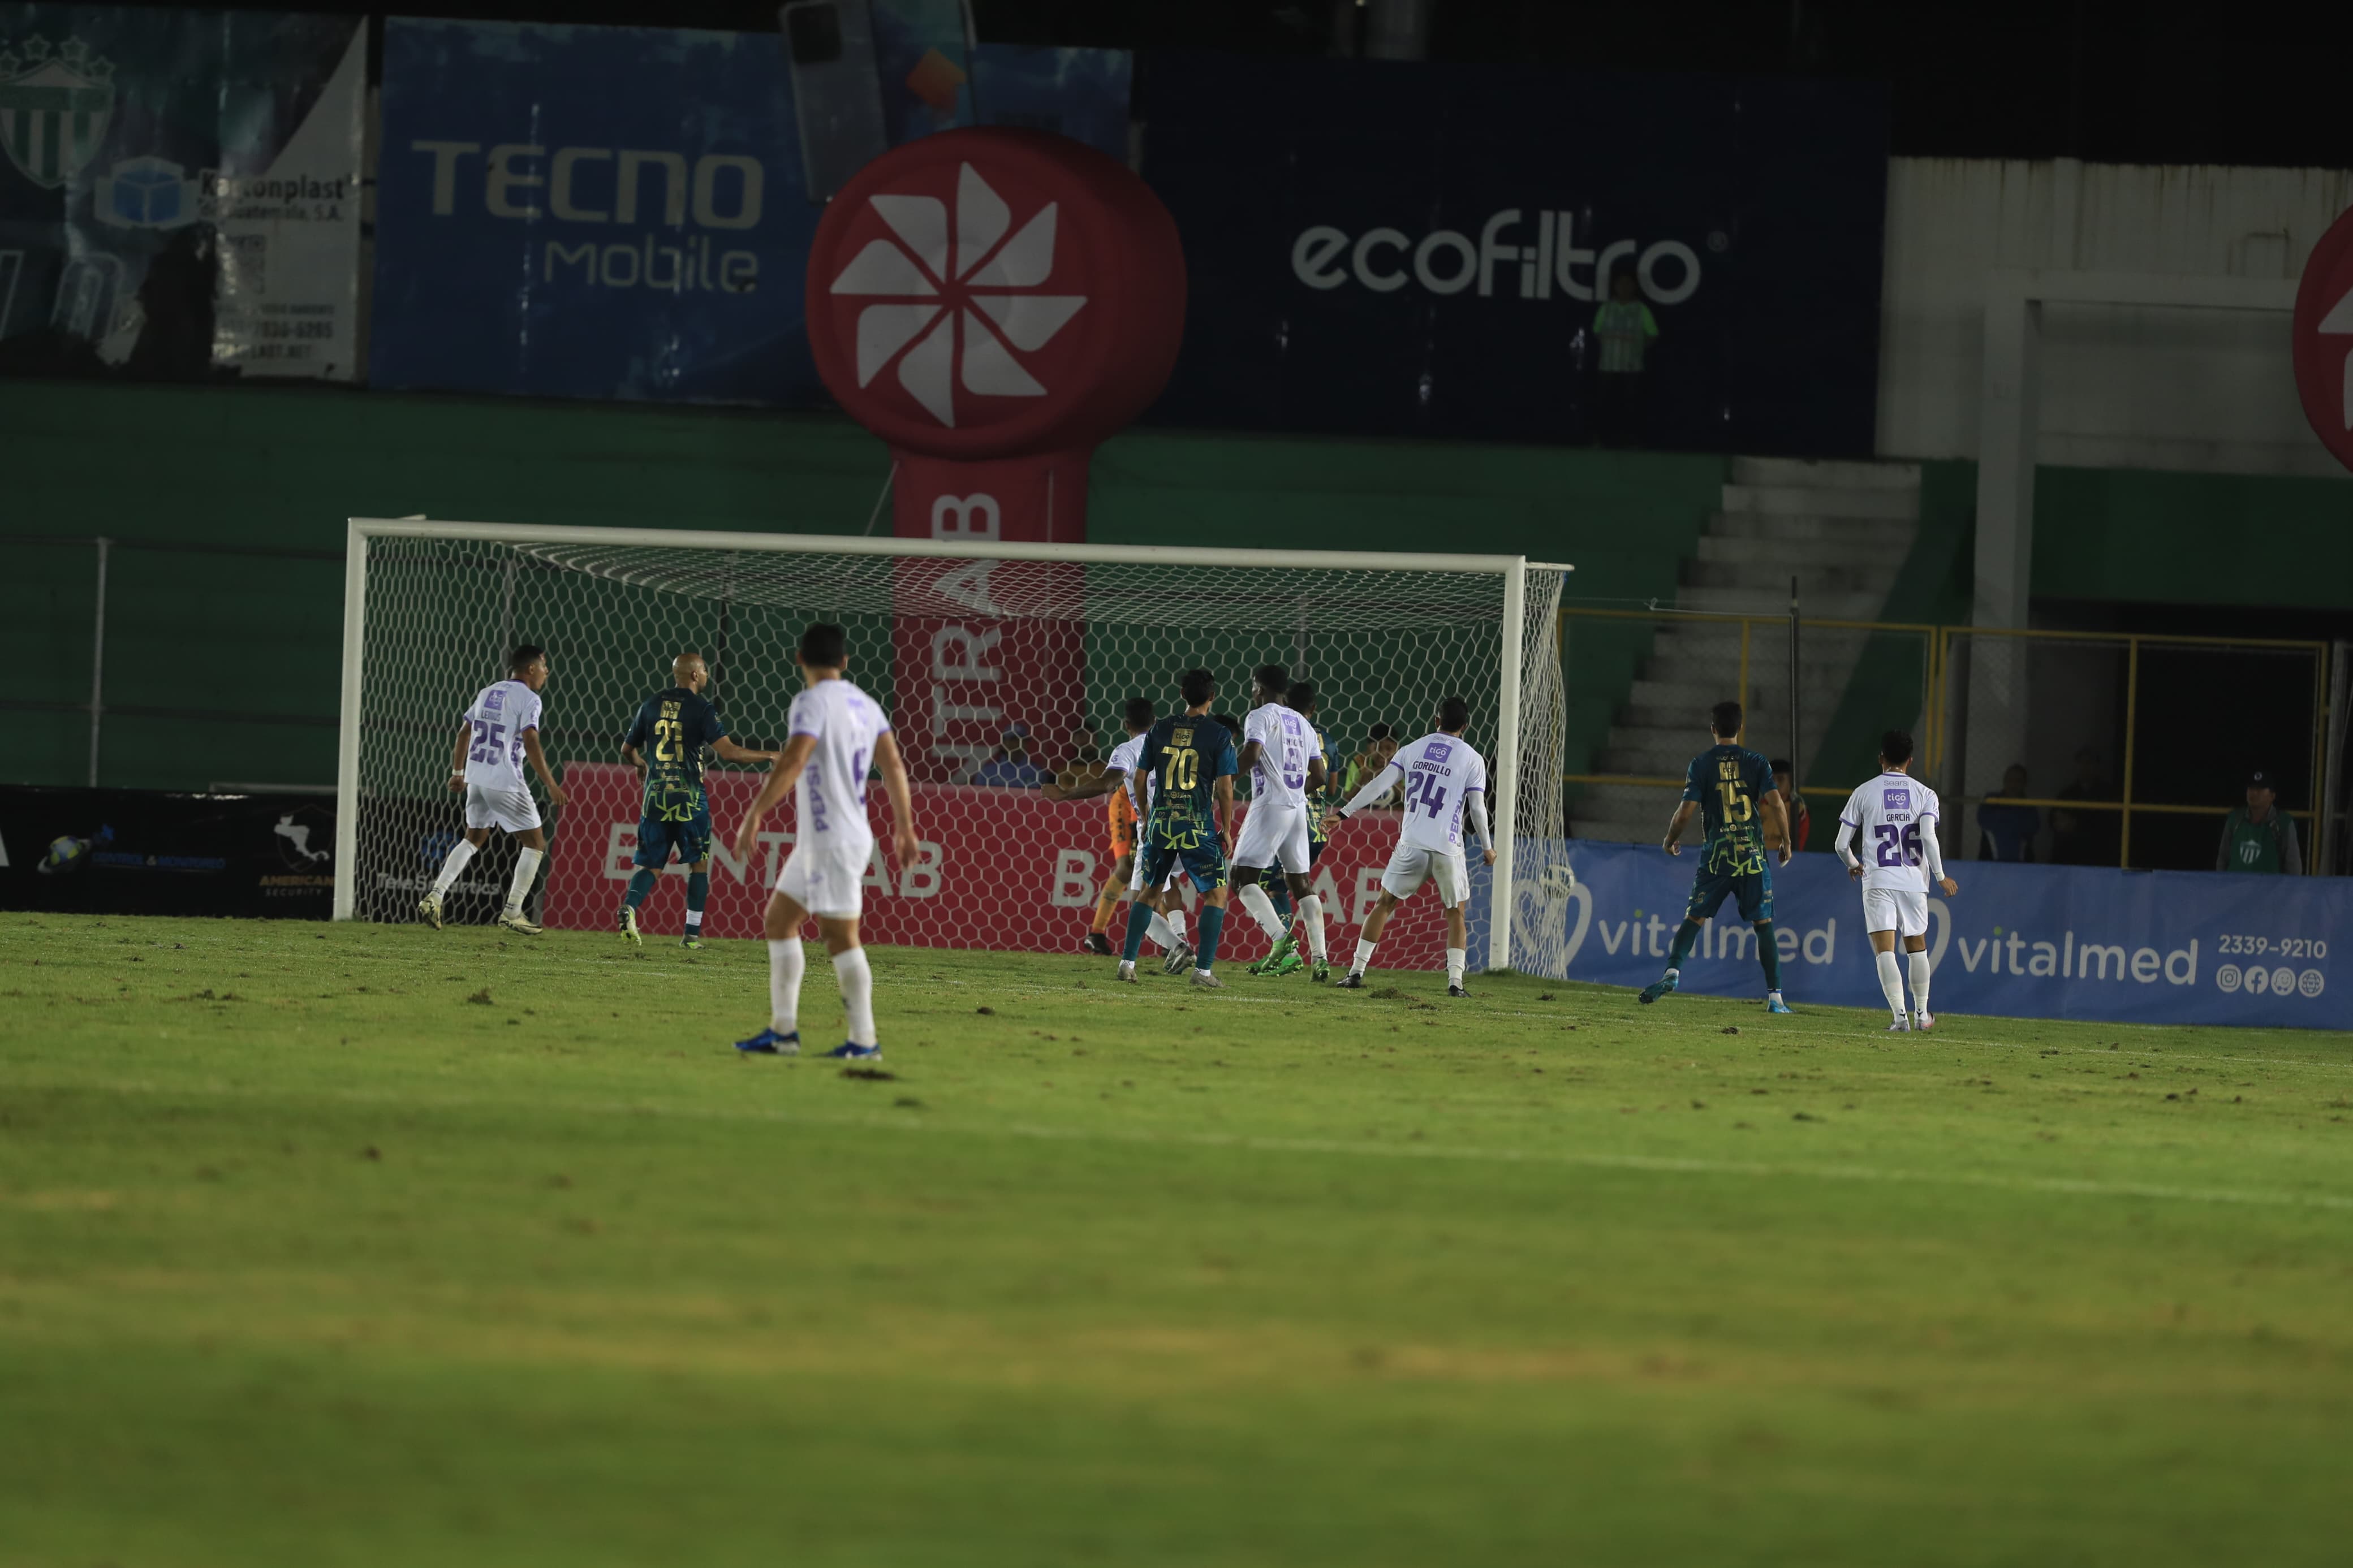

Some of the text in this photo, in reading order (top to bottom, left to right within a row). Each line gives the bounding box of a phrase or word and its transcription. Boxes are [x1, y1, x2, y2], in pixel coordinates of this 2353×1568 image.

[410, 140, 764, 230] TECNO
[1291, 208, 1701, 305] ecofiltro
[469, 720, 507, 766] 25
[654, 719, 684, 762] 21
[1175, 732, 1190, 742] tigo
[1429, 746, 1447, 758] tigo
[1160, 746, 1200, 791] 70
[1412, 761, 1451, 777] GORDILLO
[1406, 771, 1446, 819] 24
[1715, 780, 1752, 824] 15
[1887, 792, 1907, 803] tigo
[1886, 811, 1911, 822] GARCÍA
[1874, 823, 1923, 867] 26
[258, 875, 335, 887] AMERICAN
[265, 887, 322, 897] SECURITY
[377, 872, 501, 895] TeleSartics
[1958, 926, 2199, 986] vitalmed
[2218, 934, 2327, 961] 2339-9210
